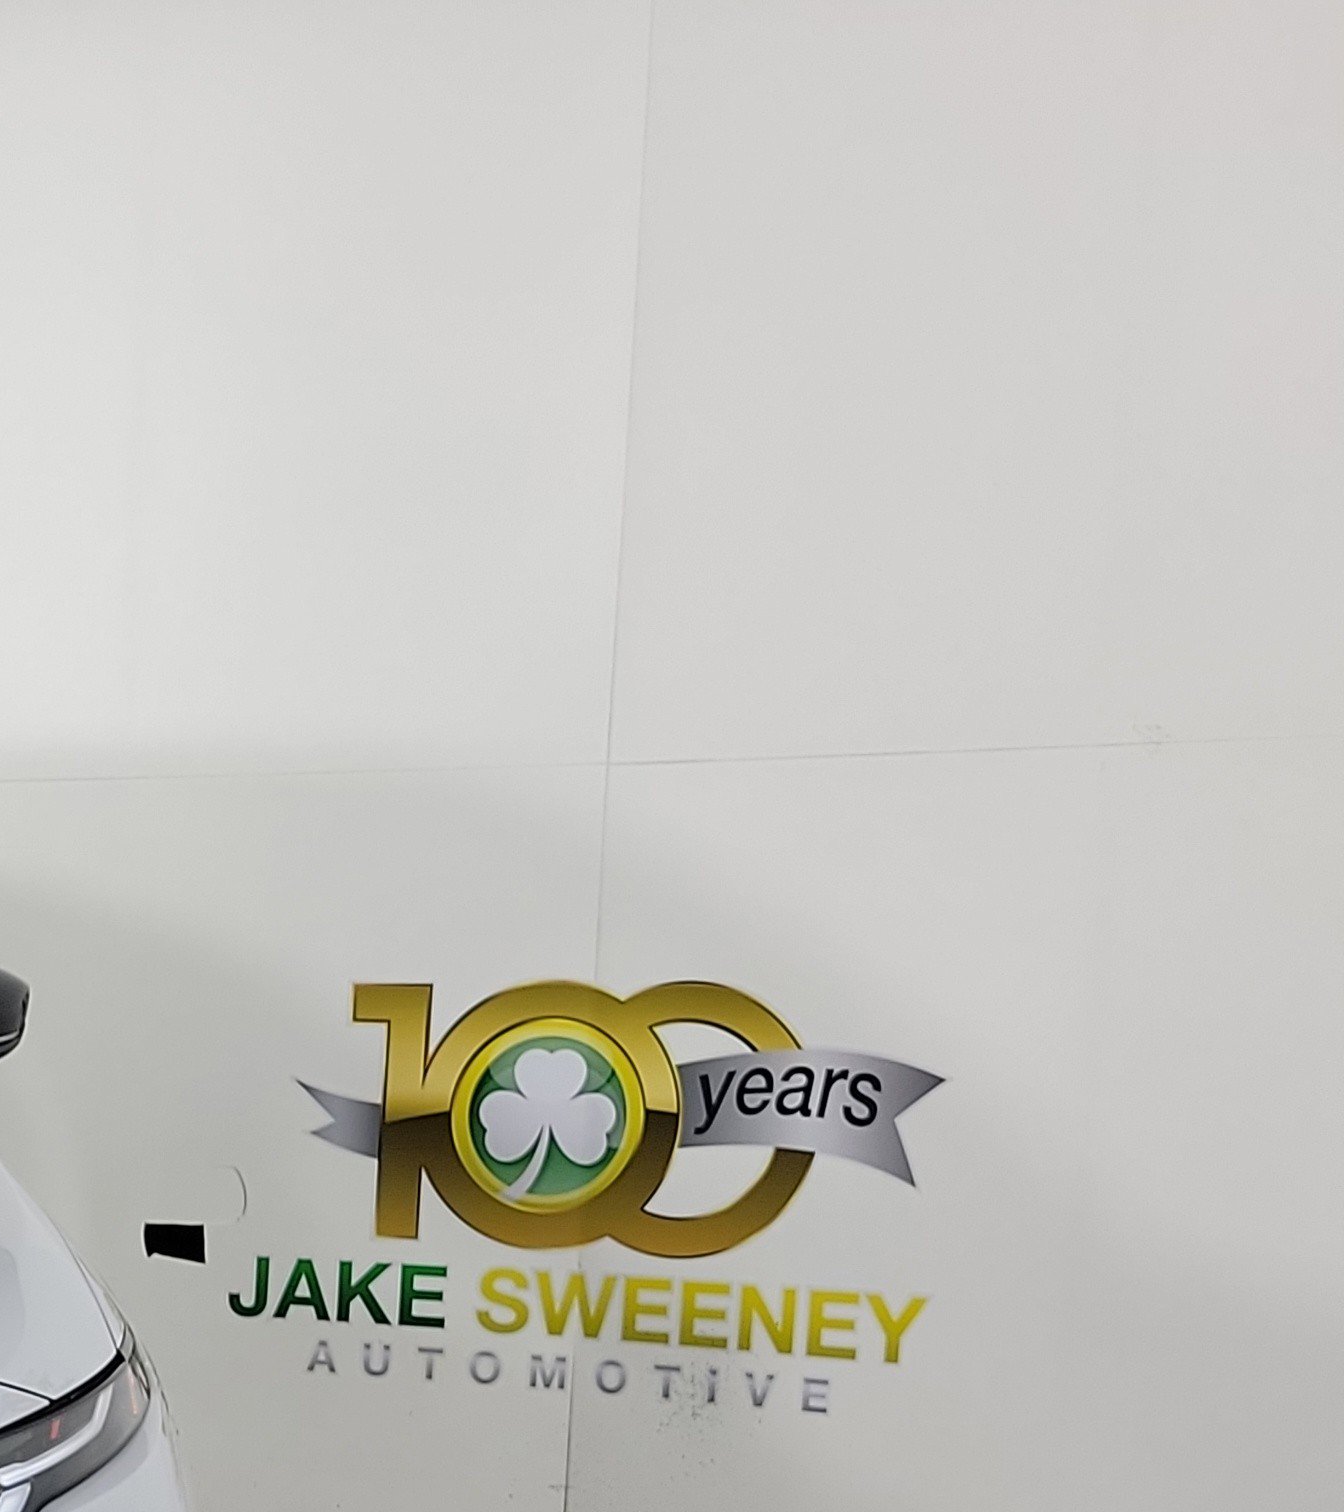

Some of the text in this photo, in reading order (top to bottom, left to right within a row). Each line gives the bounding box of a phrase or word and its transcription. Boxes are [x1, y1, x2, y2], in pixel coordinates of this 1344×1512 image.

[352, 980, 883, 1258] 100 years
[228, 1255, 928, 1365] JAKE SWEENEY
[307, 1339, 830, 1414] AUTOMOTIVE
